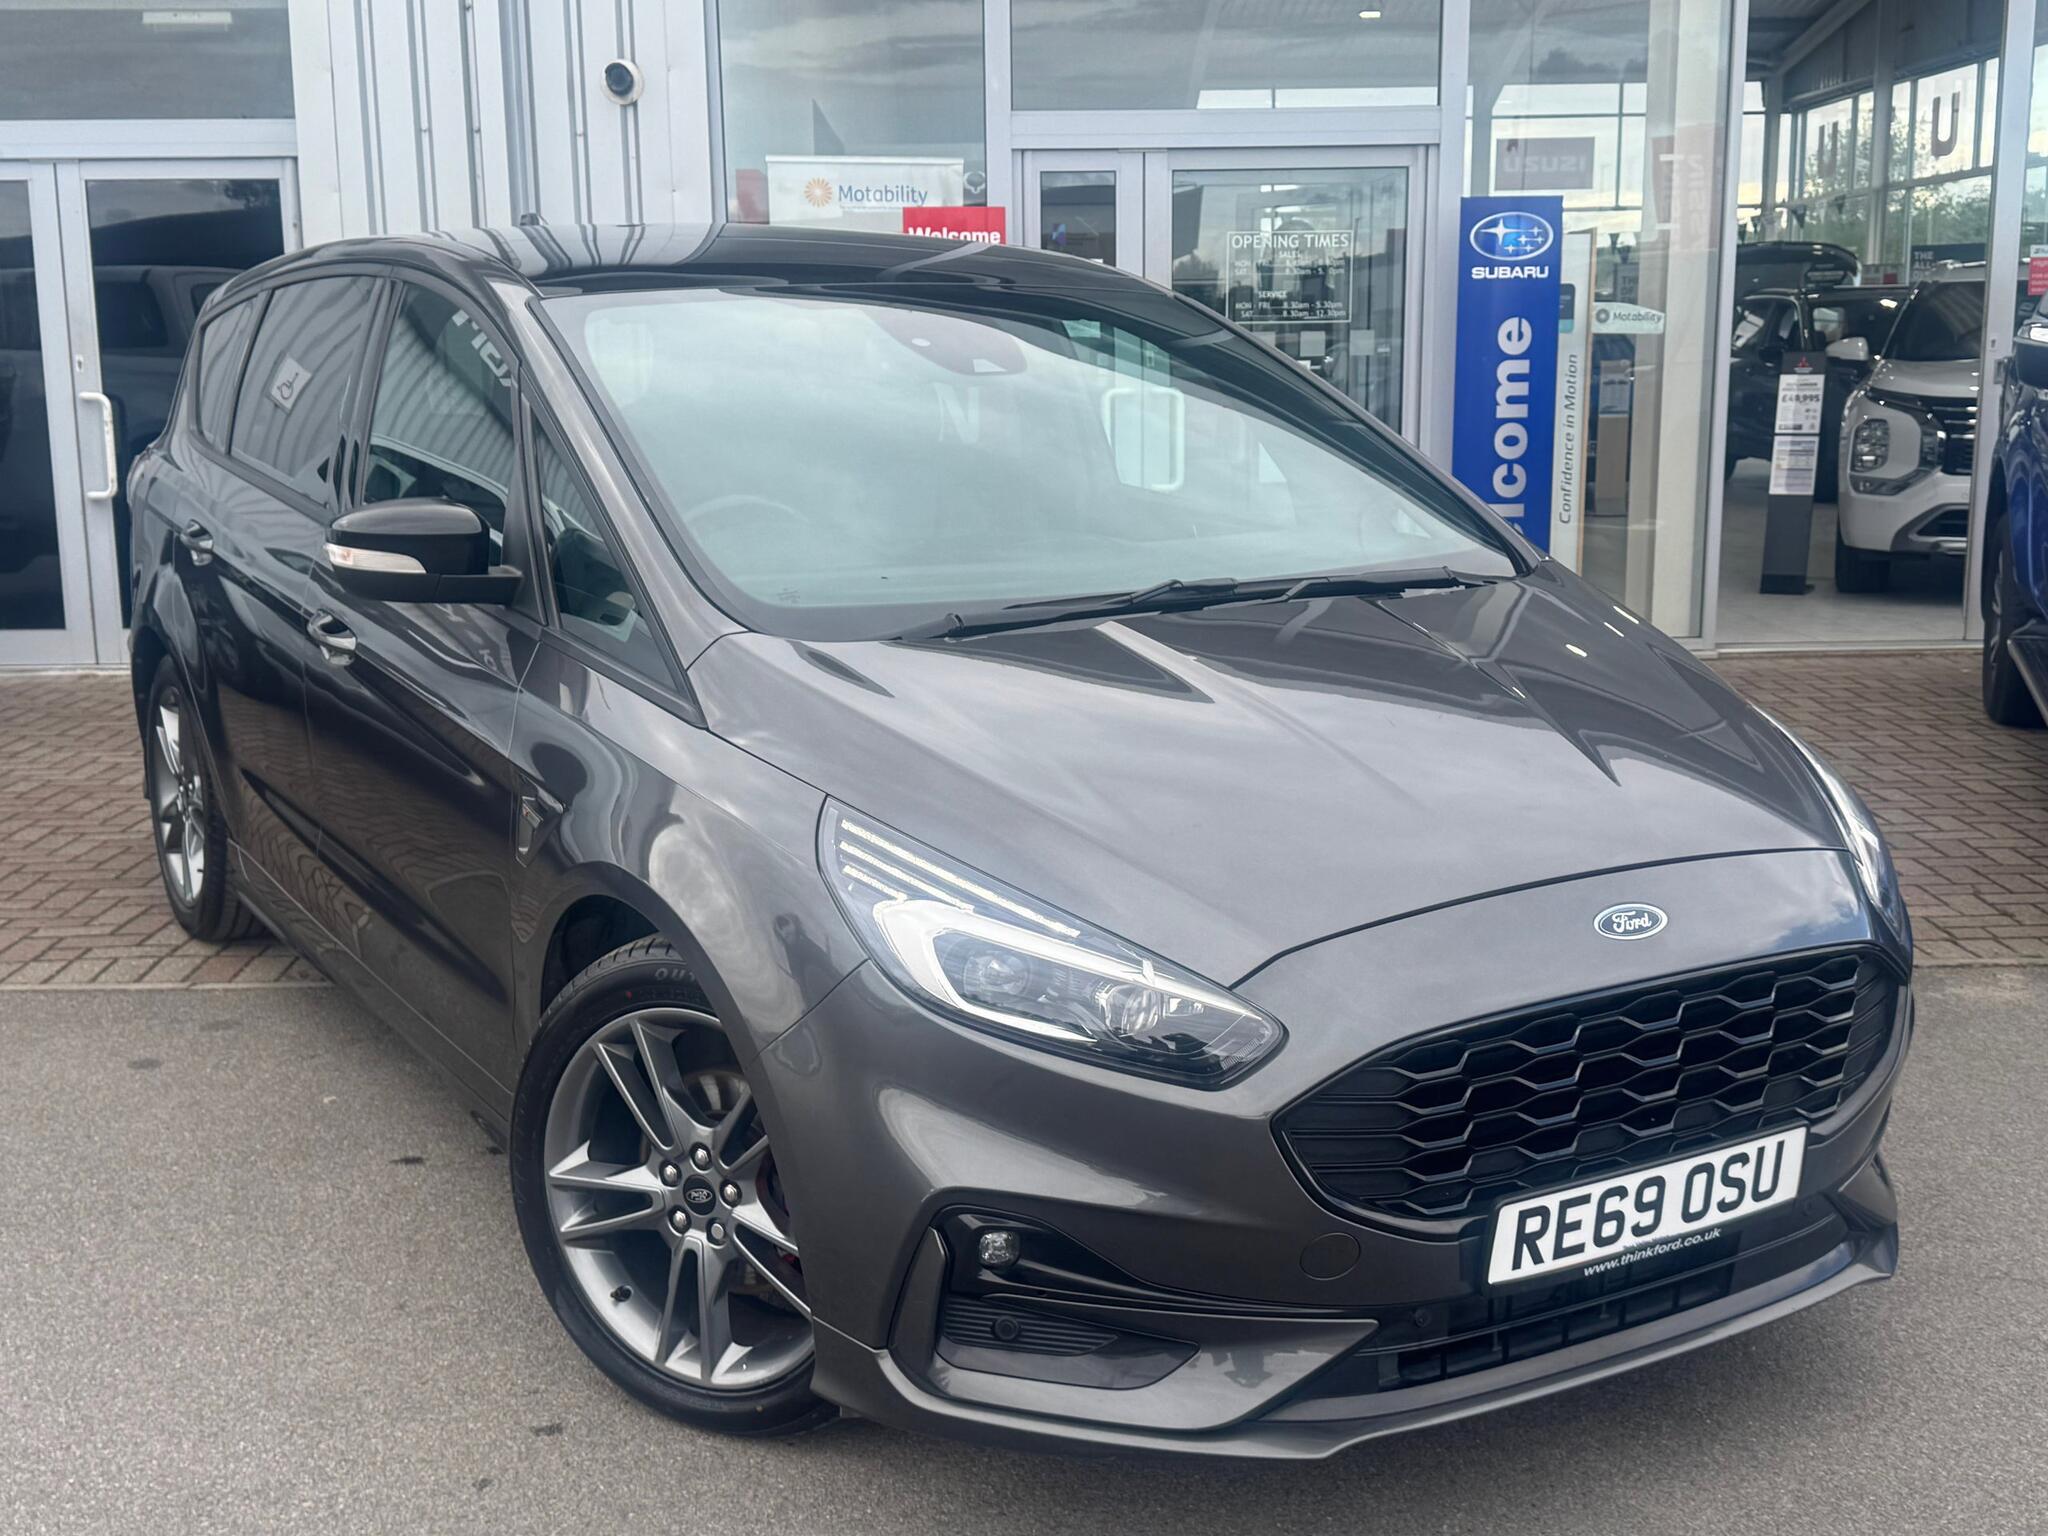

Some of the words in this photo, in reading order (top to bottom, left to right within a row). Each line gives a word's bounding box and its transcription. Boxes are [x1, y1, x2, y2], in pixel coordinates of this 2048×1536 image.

[839, 184, 928, 205] Motability
[1231, 234, 1299, 249] OPENING
[1303, 233, 1349, 248] TIMES
[1471, 265, 1549, 279] SUBARU
[1258, 290, 1288, 299] SERVICE
[1613, 311, 1663, 324] Motability
[1564, 353, 1578, 411] Motion
[1490, 316, 1533, 535] lcome
[1563, 413, 1575, 429] in
[1559, 431, 1575, 525] Confidence
[1611, 910, 1653, 933] Ford
[1511, 1174, 1667, 1272] RE69
[1681, 1139, 1786, 1224] OSU
[1583, 1227, 1722, 1277] www.thinkford.co.uk
